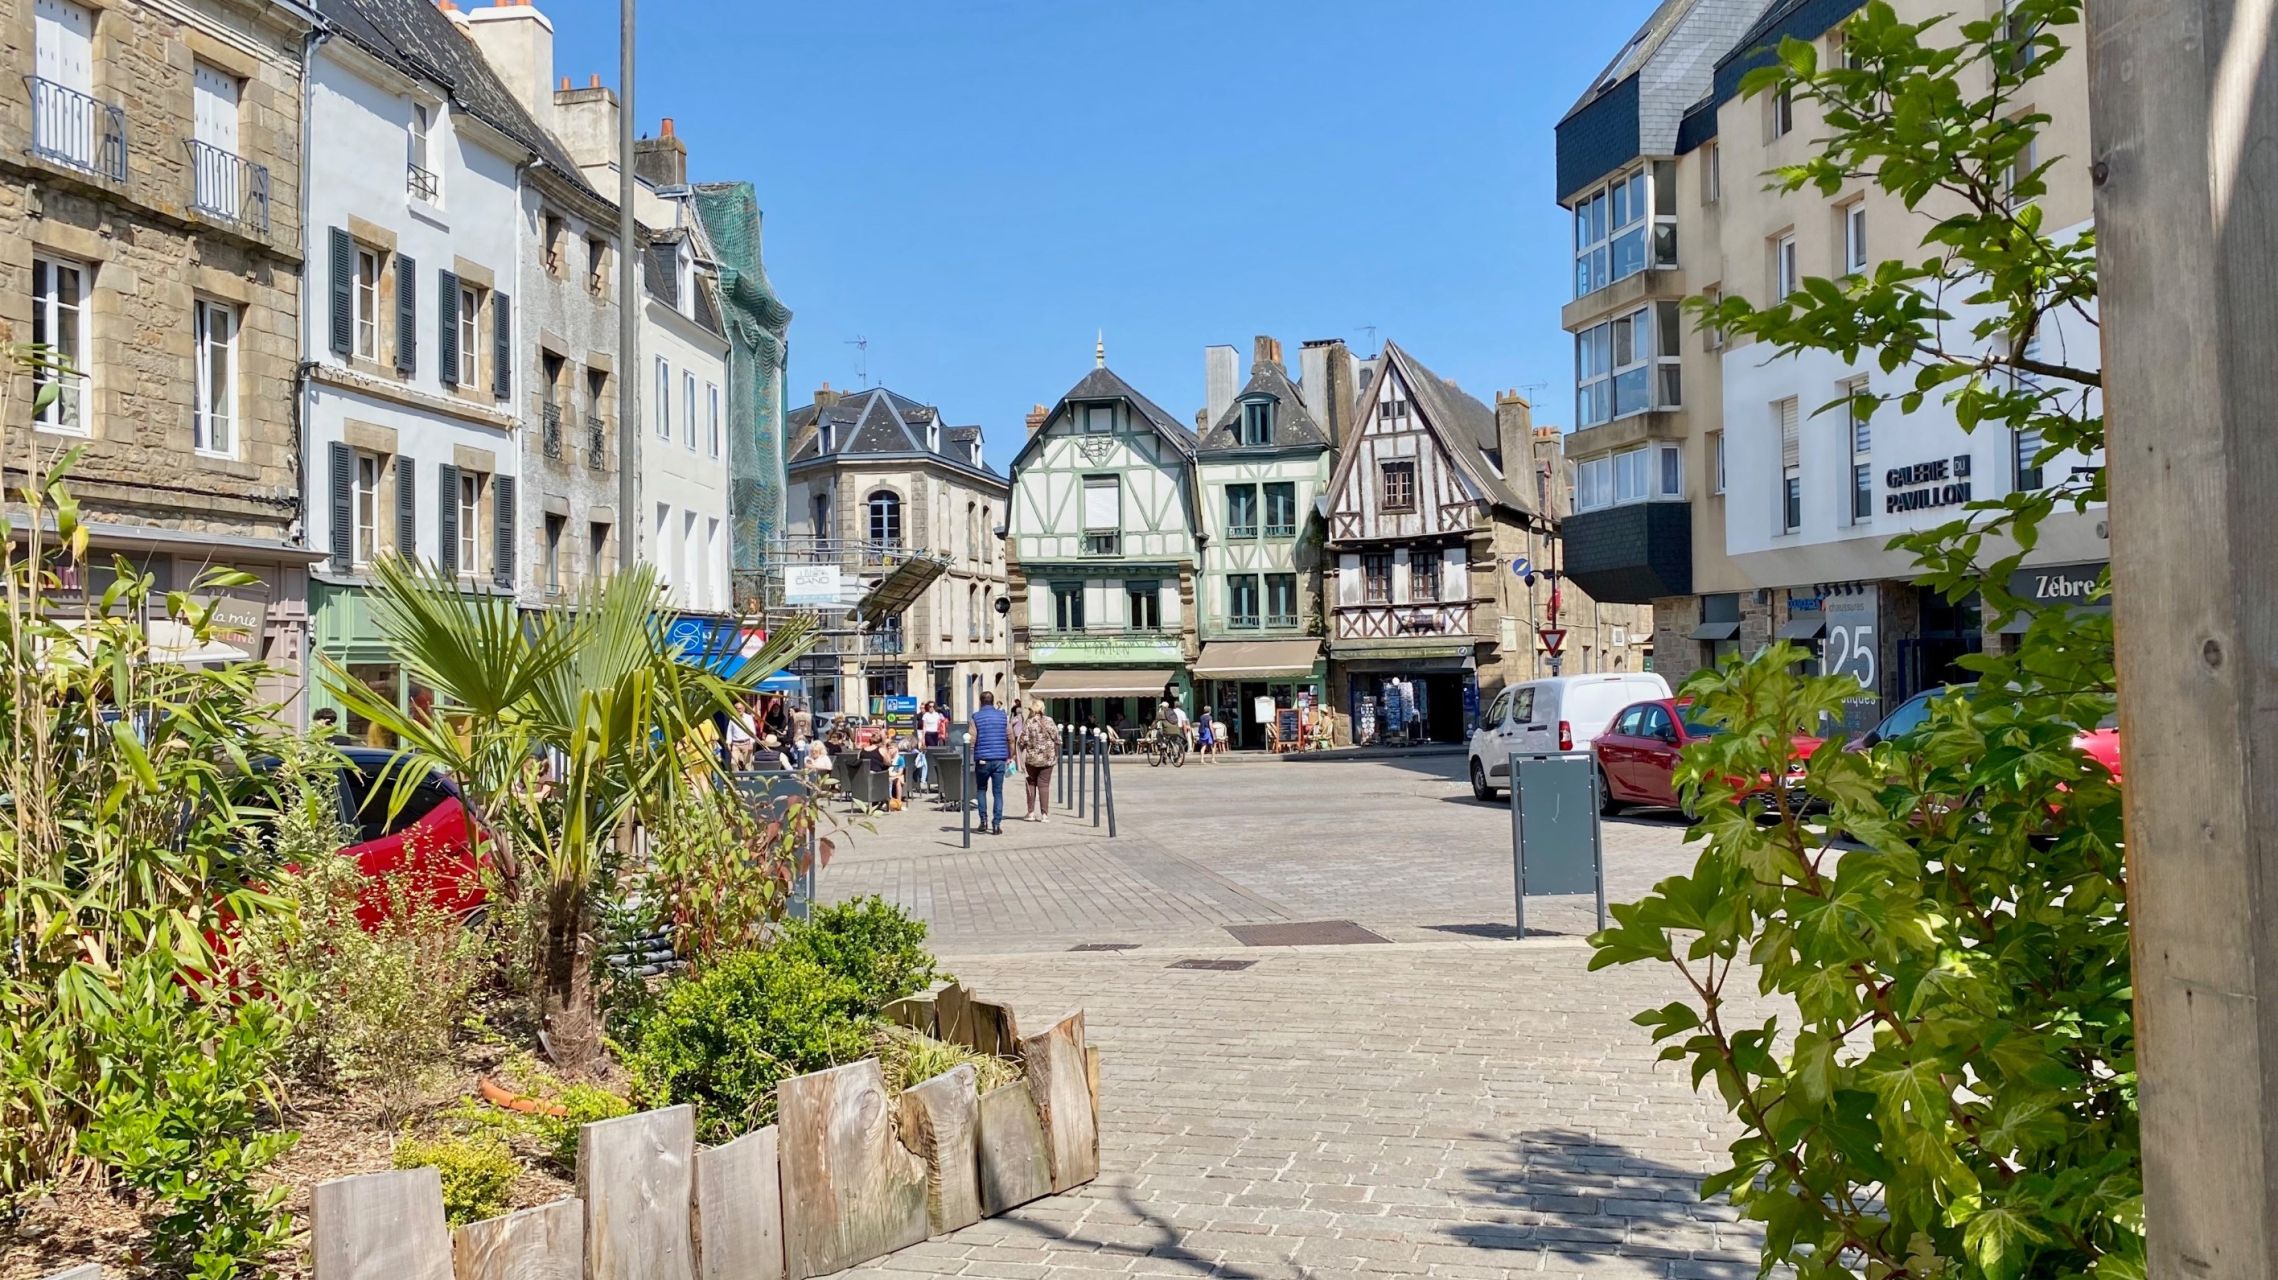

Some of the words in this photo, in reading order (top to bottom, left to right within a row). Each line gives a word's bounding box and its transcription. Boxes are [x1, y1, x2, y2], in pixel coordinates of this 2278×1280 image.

[1886, 459, 1949, 488] GALERIE
[1886, 482, 1971, 514] PAVILLON
[228, 610, 258, 628] mie
[1829, 625, 1875, 689] 25
